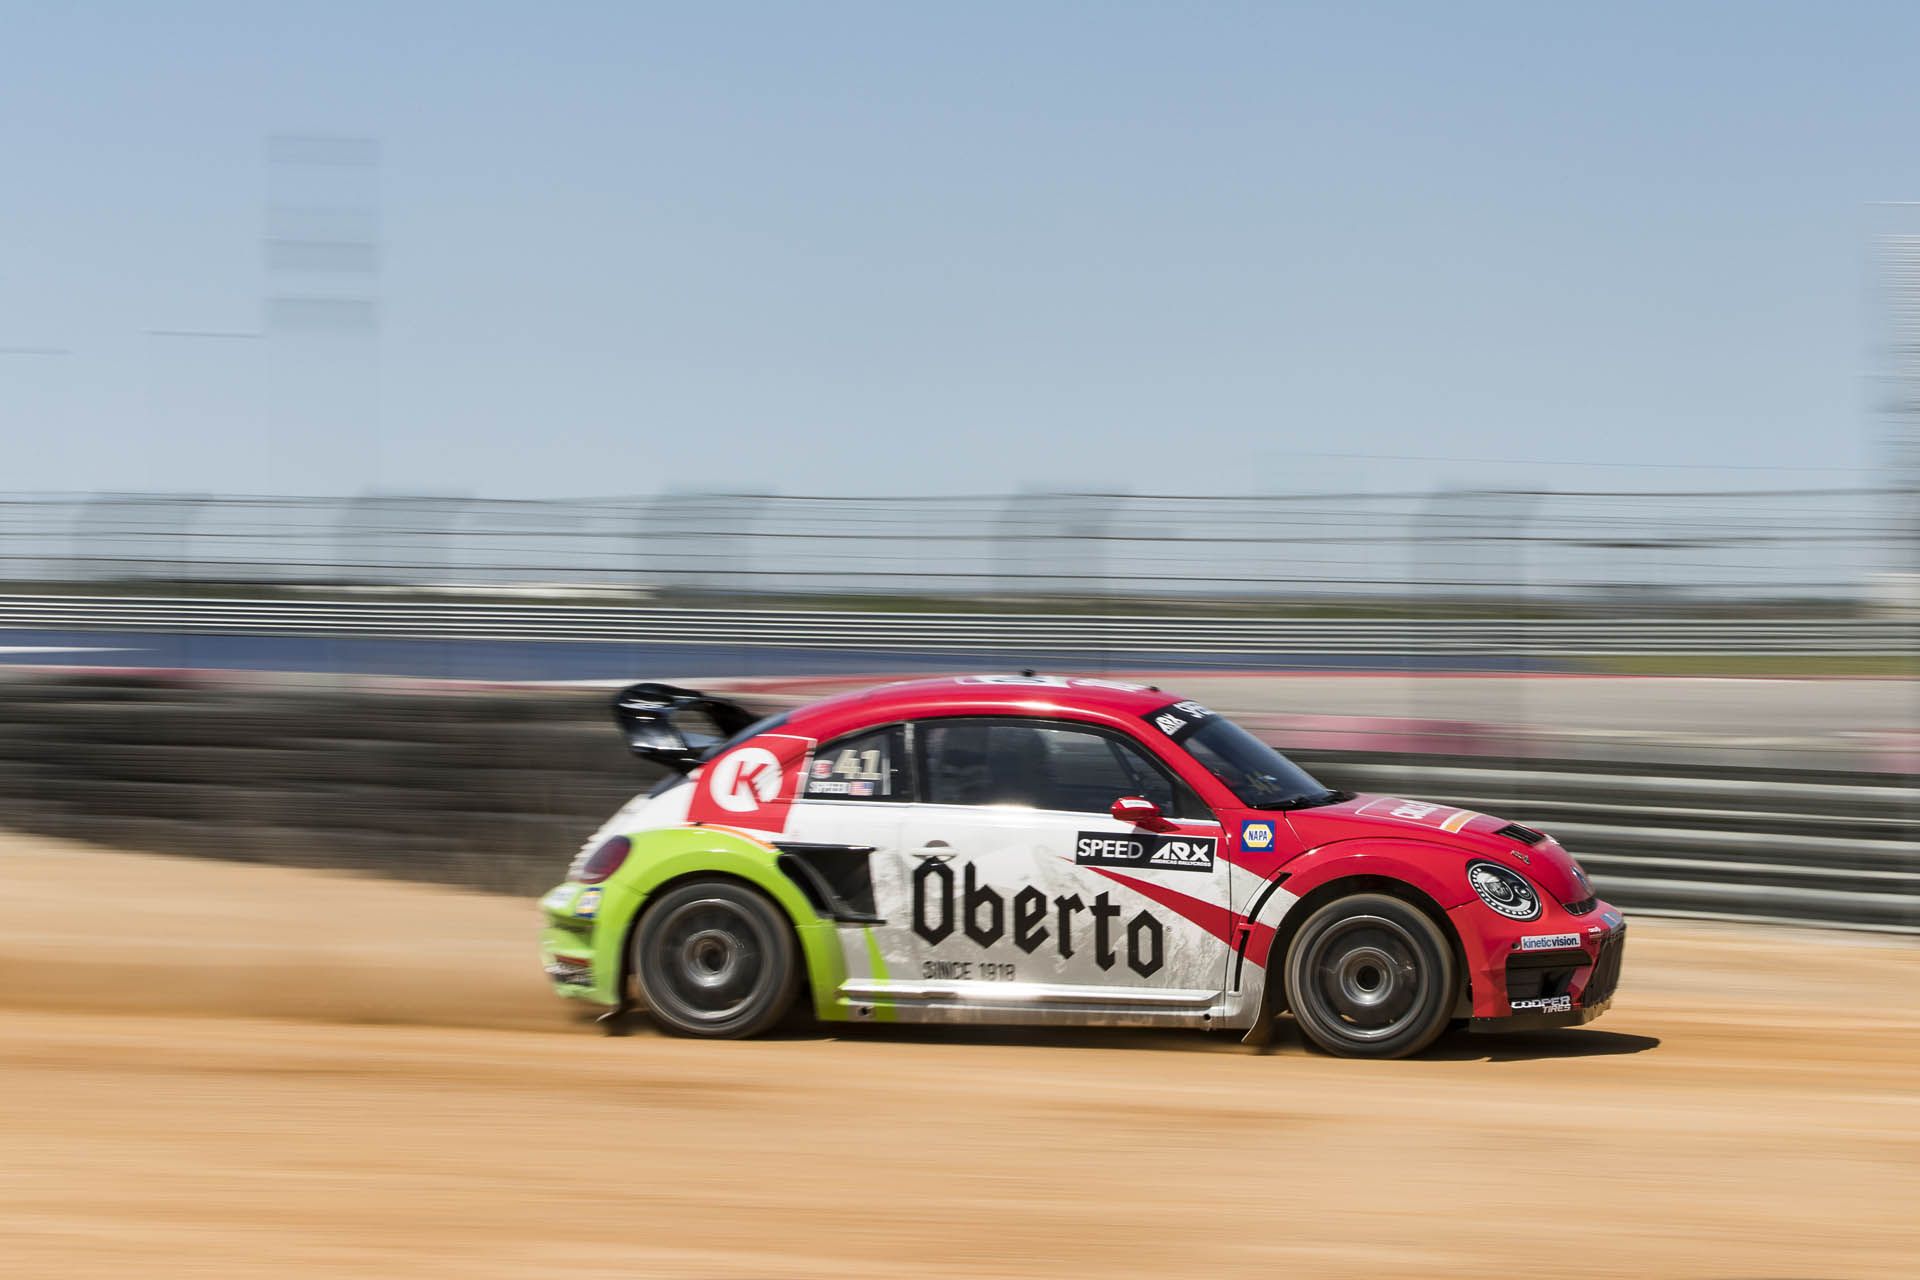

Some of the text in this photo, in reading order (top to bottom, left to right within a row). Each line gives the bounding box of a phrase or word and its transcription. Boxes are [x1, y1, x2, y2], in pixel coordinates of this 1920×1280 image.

[833, 749, 883, 780] 41
[1248, 830, 1268, 841] NAPA
[1078, 838, 1210, 861] SPEED ARX
[922, 960, 972, 980] SINCE
[1511, 996, 1571, 1009] COOPER
[1543, 1004, 1571, 1014] TIRES
